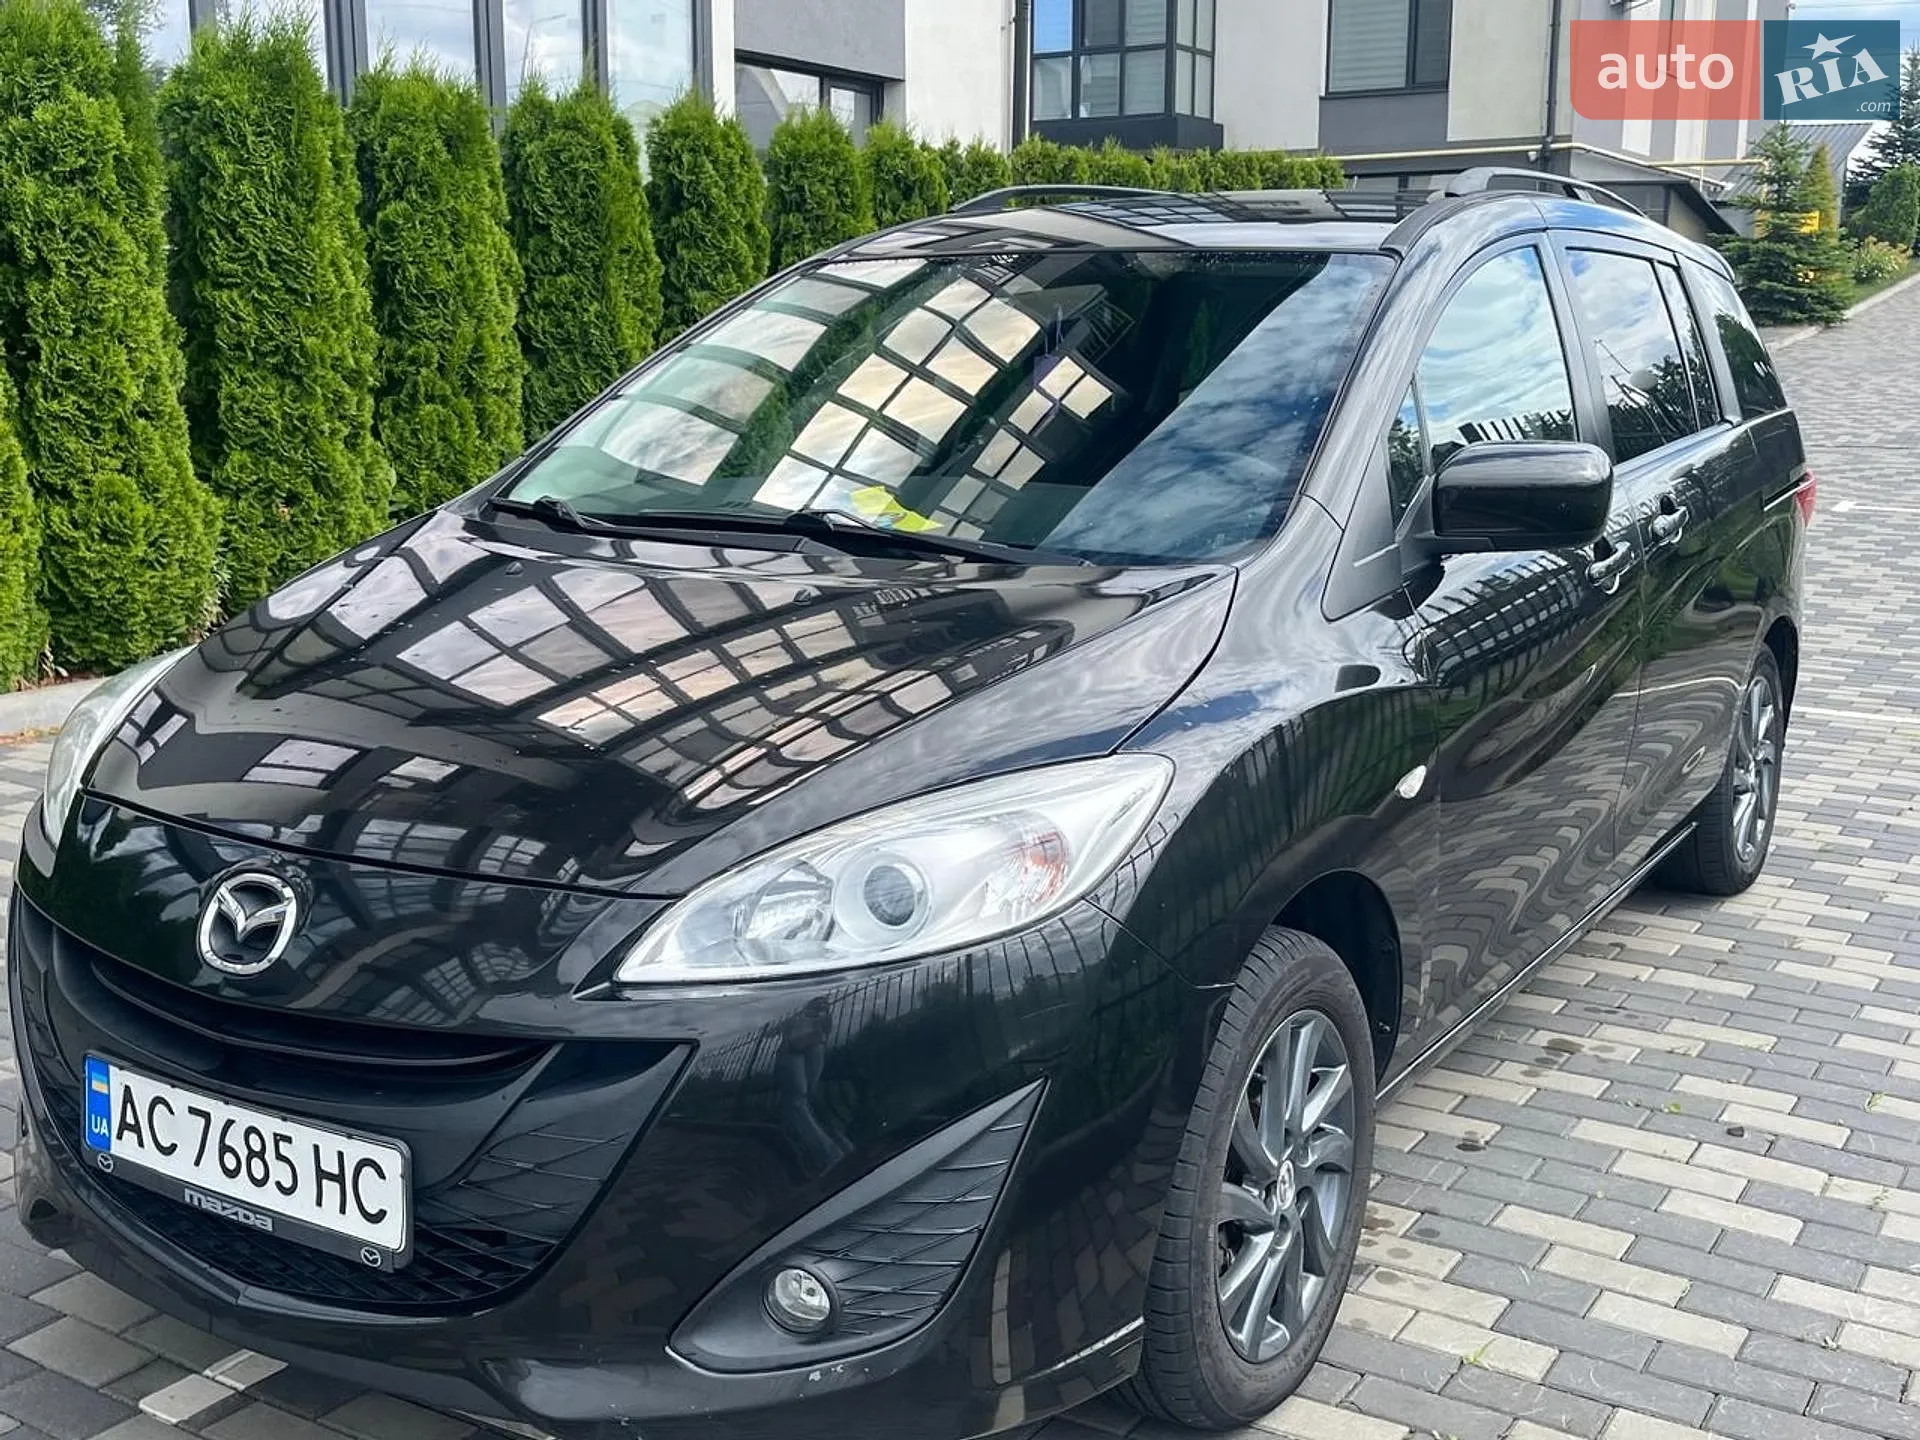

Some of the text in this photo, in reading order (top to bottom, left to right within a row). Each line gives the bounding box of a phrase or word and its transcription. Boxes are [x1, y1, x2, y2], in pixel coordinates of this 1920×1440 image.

[91, 1116, 109, 1136] UA
[116, 1085, 387, 1224] AC 7685 HC
